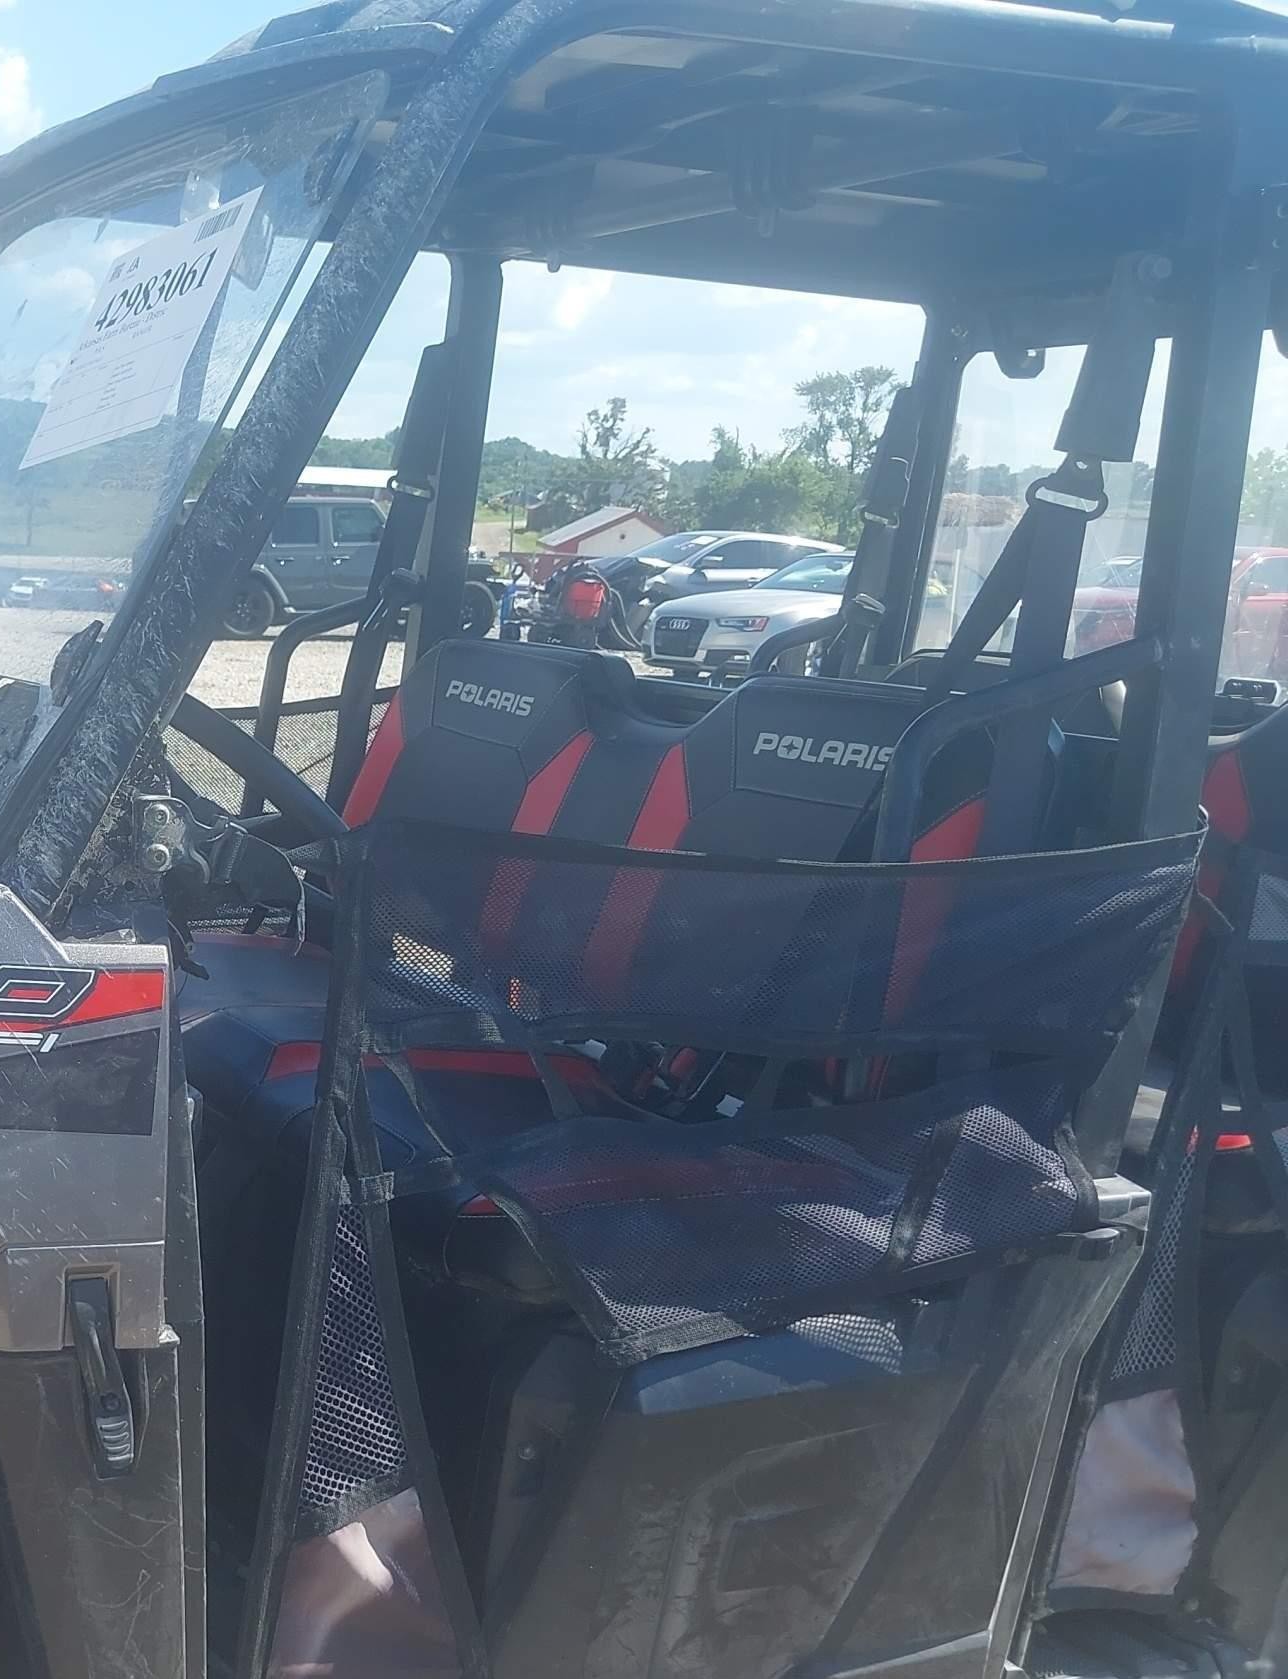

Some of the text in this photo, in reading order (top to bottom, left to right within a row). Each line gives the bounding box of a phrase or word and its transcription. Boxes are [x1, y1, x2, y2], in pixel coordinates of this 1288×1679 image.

[94, 248, 218, 332] 42983061
[445, 680, 535, 716] POLARIS
[753, 732, 895, 771] POLARIS
